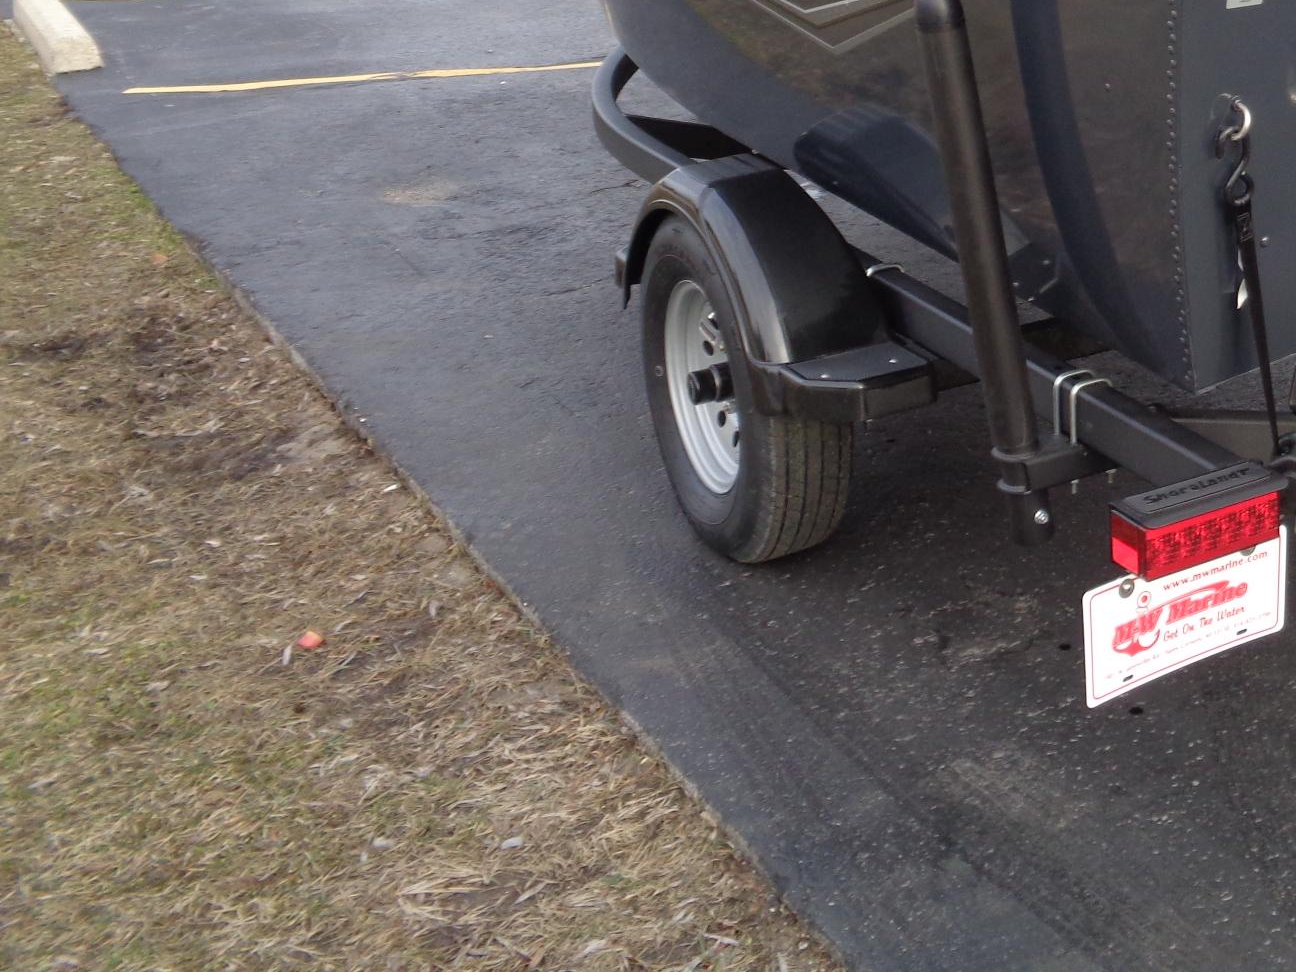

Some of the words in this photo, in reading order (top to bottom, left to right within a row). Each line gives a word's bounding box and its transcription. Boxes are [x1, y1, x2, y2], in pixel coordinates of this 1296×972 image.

[1162, 550, 1268, 592] www.mwmarine.com
[1163, 627, 1179, 643] Get
[1182, 622, 1197, 635] On
[1199, 615, 1214, 629] The
[1216, 606, 1246, 623] Water
[1165, 581, 1249, 626] Marine
